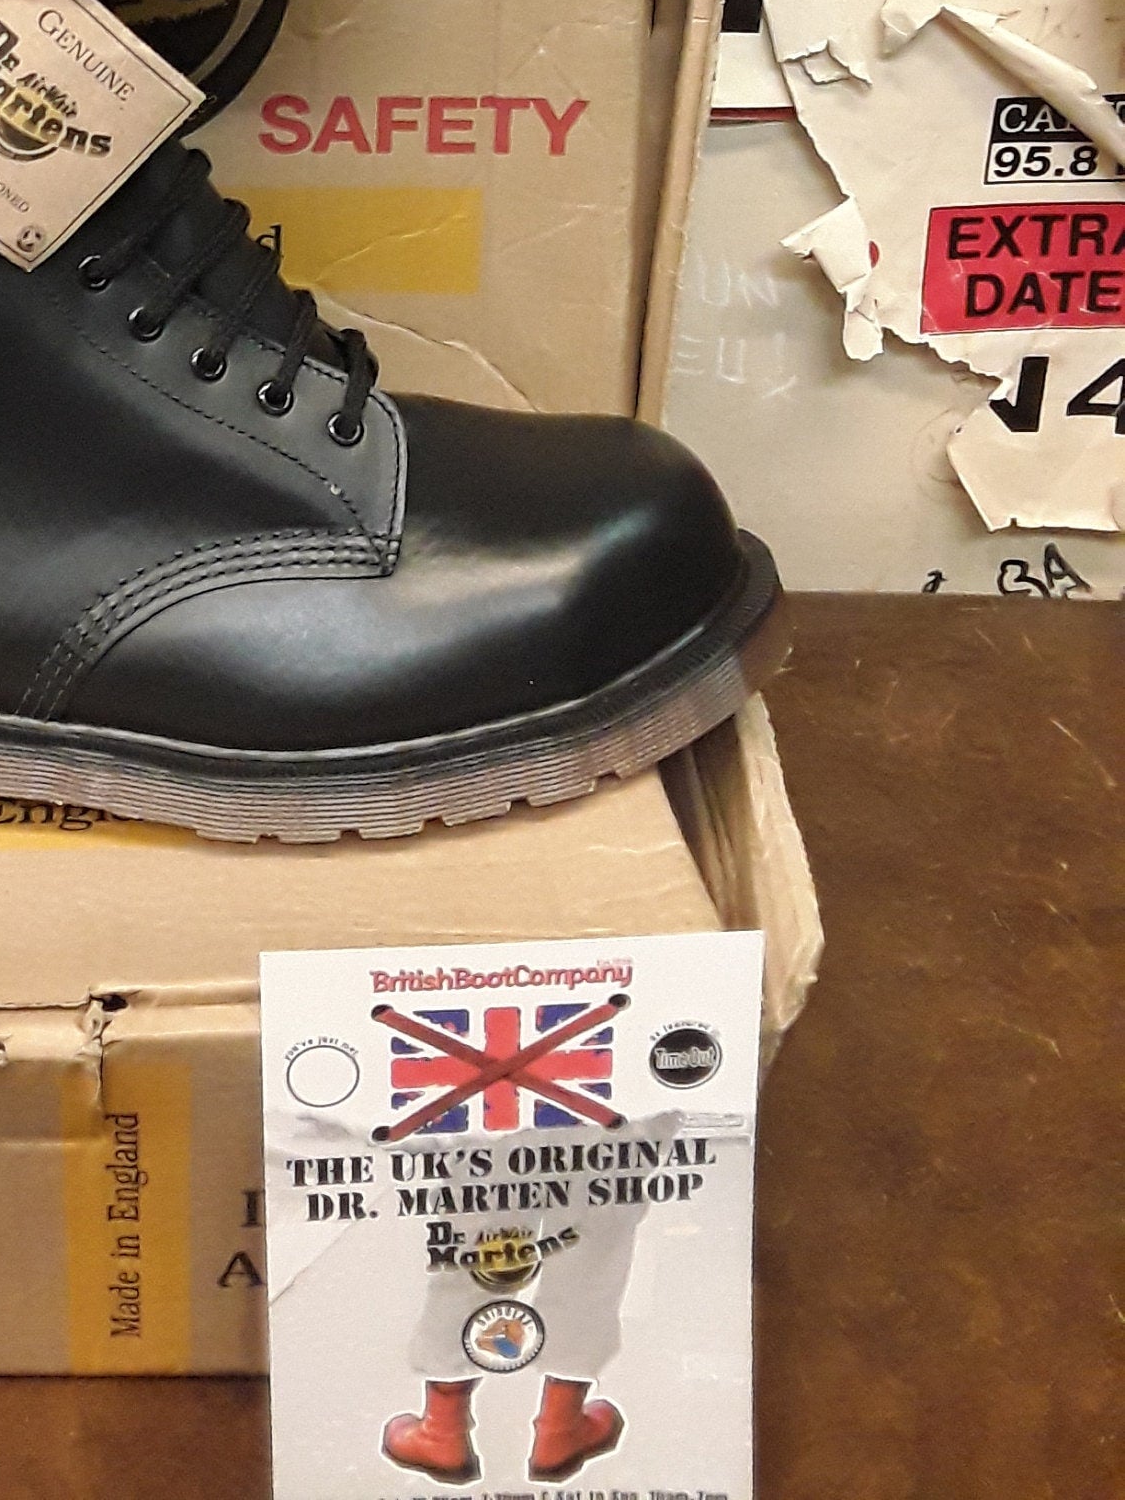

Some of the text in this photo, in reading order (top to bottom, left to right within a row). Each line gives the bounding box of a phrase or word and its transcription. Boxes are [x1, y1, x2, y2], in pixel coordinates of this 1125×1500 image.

[37, 8, 138, 103] GENUINE
[259, 94, 591, 157] SAFETY
[998, 102, 1079, 134] CA
[993, 145, 1099, 178] 95.8
[369, 964, 634, 994] BritishBootCompany
[286, 1138, 717, 1188] THE UK'S ORIGINAL
[306, 1172, 704, 1222] DR. MARTEN SHOP
[104, 1111, 149, 1339] Made in England
[426, 1226, 580, 1274] Martens
